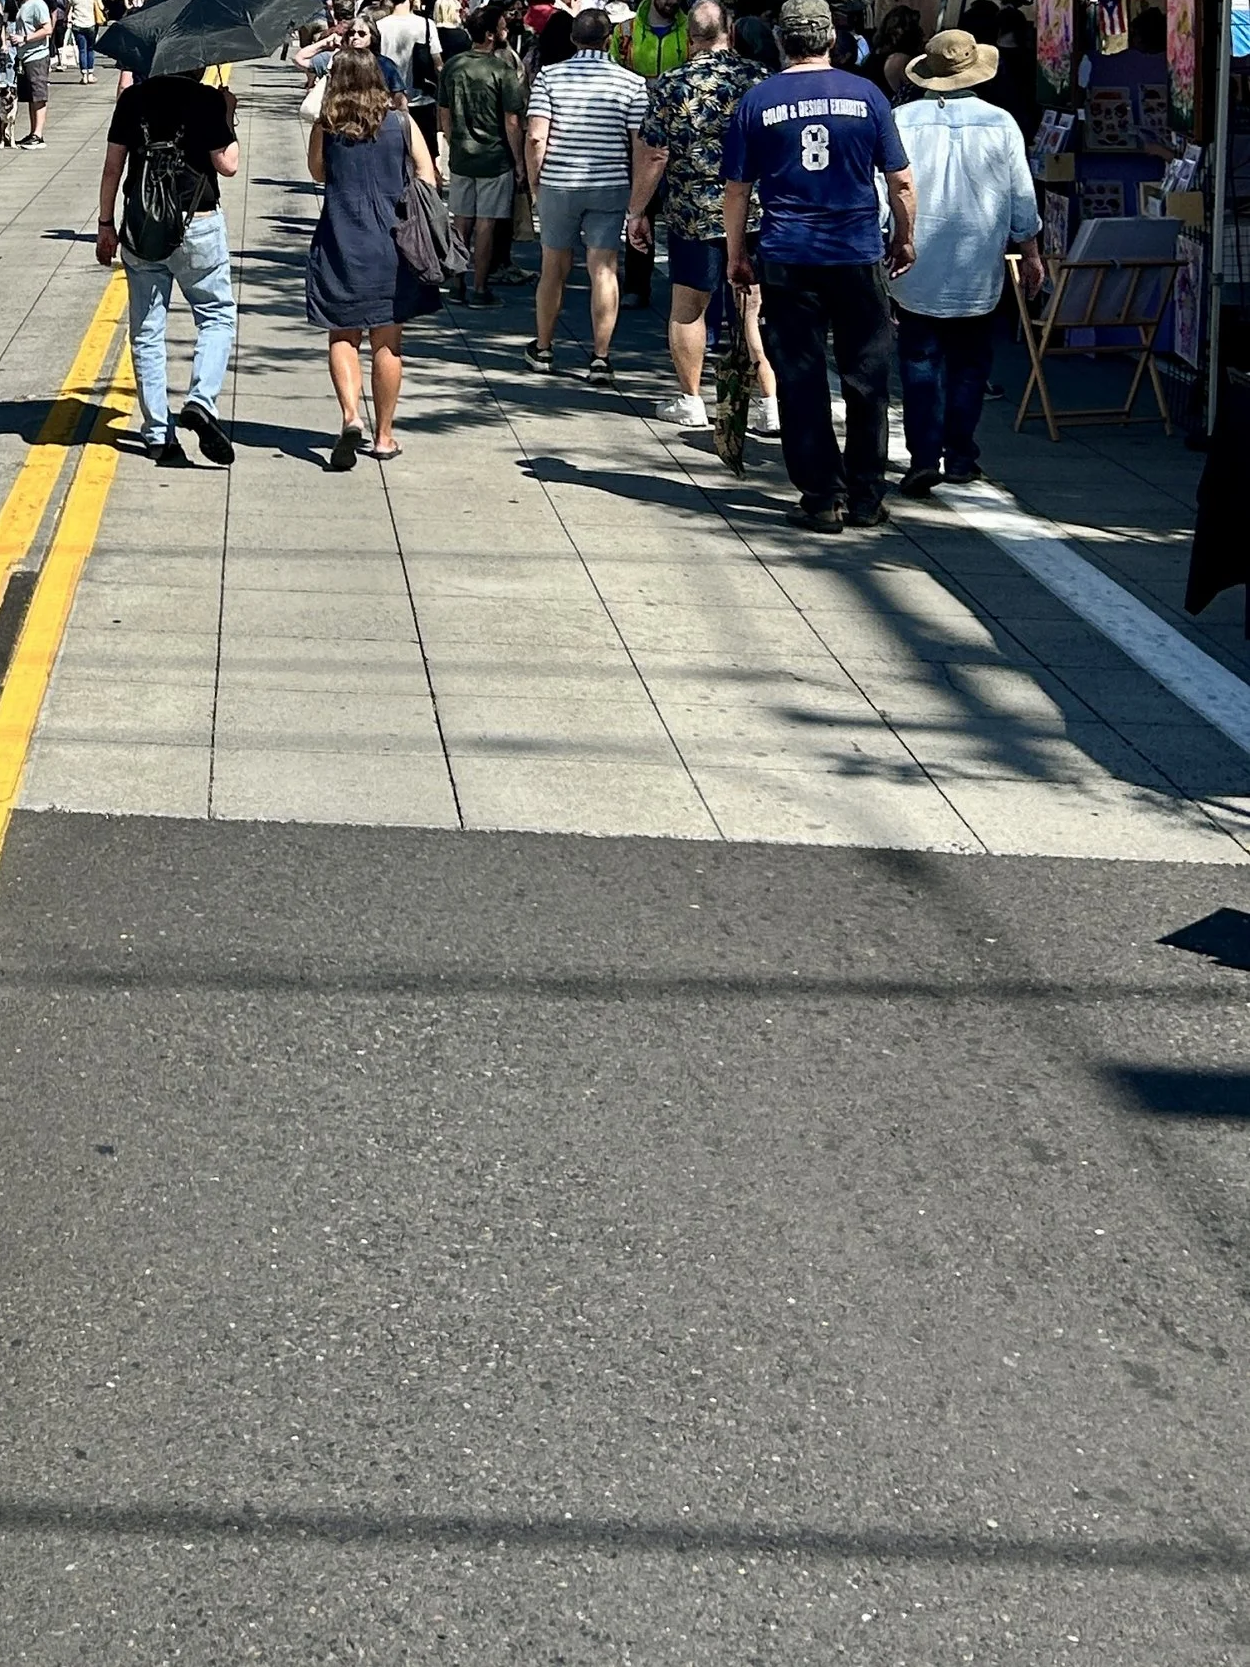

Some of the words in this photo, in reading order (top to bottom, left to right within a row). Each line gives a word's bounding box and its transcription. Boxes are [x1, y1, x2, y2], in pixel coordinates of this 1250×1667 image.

[790, 104, 798, 119] &
[798, 99, 829, 118] DESIGN
[801, 124, 829, 171] 8
